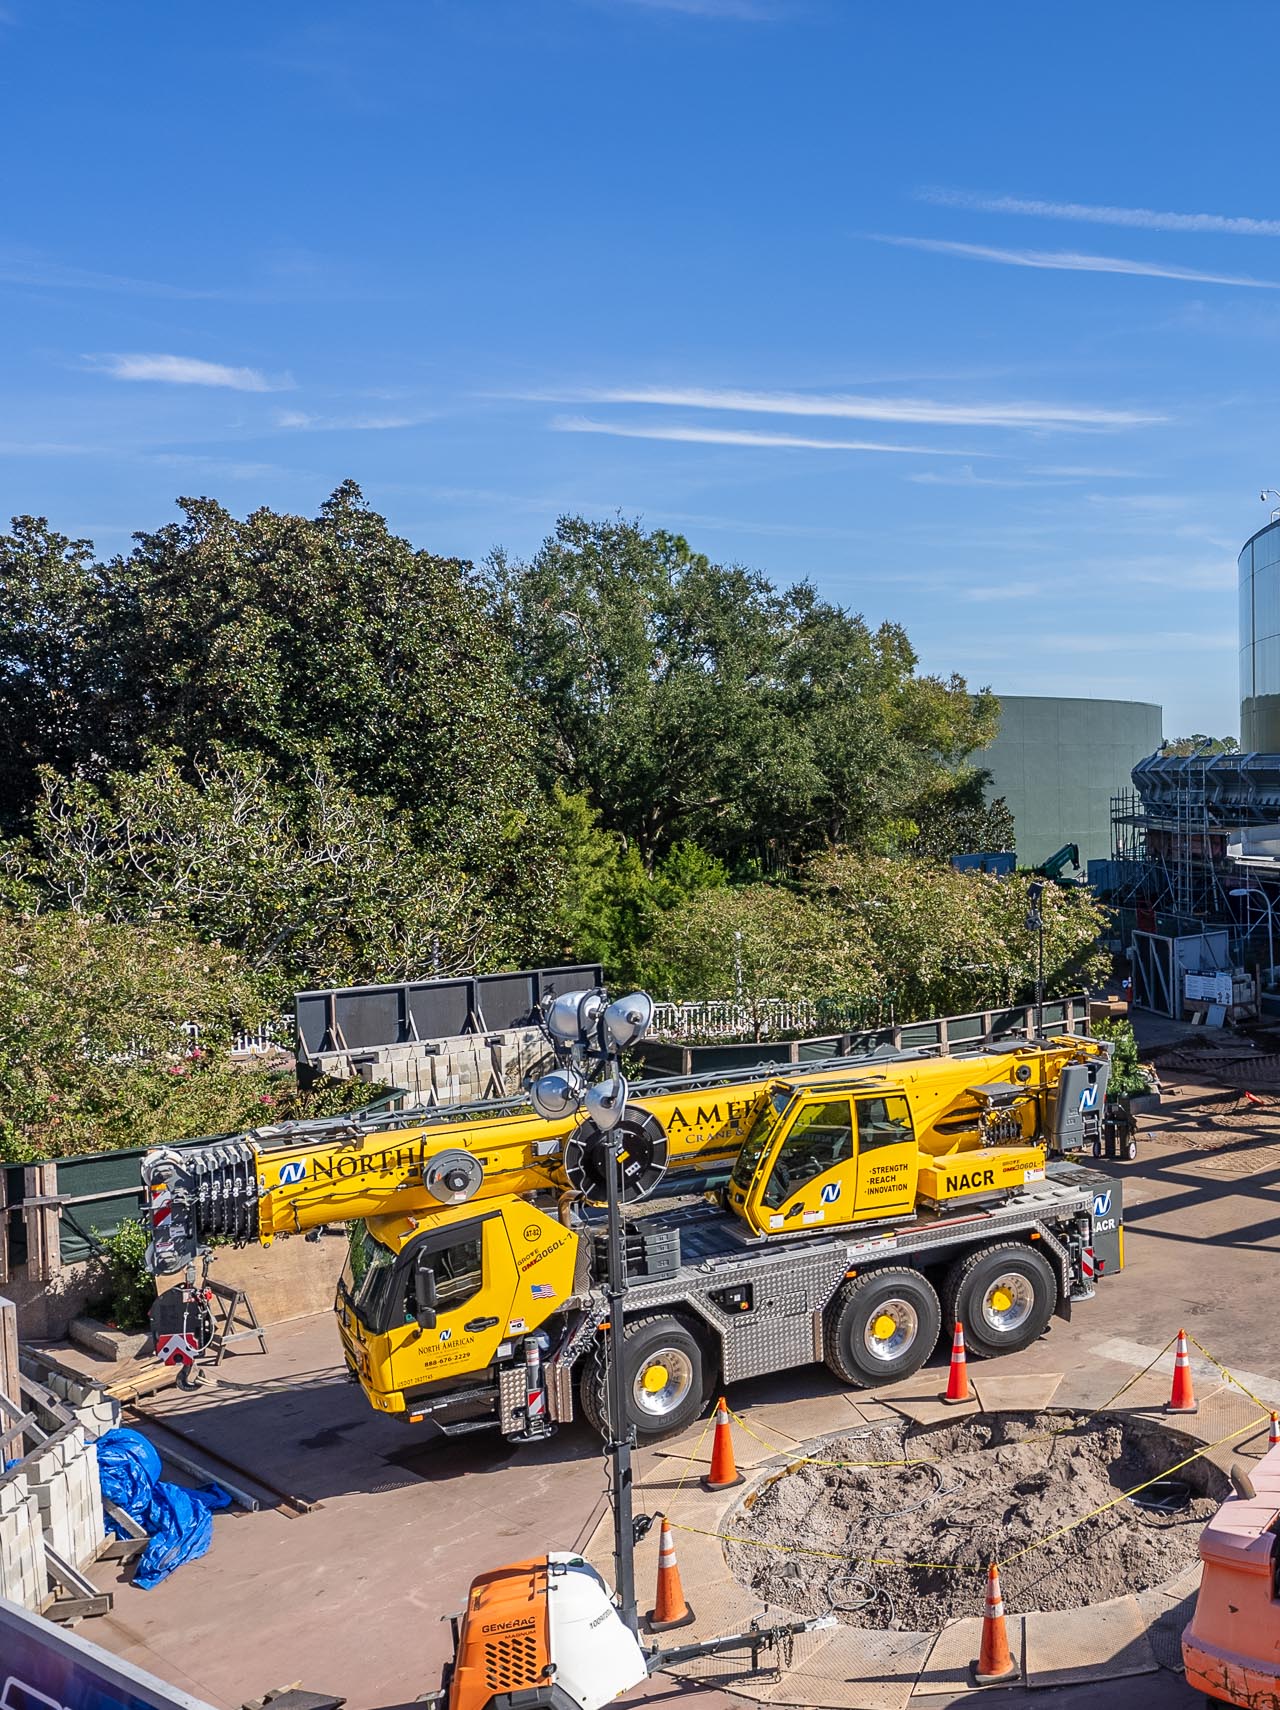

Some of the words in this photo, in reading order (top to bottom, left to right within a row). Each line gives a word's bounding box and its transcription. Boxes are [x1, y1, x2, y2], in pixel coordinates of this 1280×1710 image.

[313, 1147, 415, 1182] NORTH
[871, 1163, 909, 1175] STRENGTH
[869, 1175, 897, 1185] REACH
[946, 1169, 994, 1193] NACR
[867, 1183, 908, 1196] INNOVATION
[517, 1248, 539, 1266] GROVE
[418, 1344, 441, 1356] NORTH
[442, 1335, 475, 1351] AMERICAN
[424, 1352, 471, 1368] 888-676-2229
[482, 1616, 536, 1634] GENERAC
[504, 1629, 537, 1640] MAGNUM
